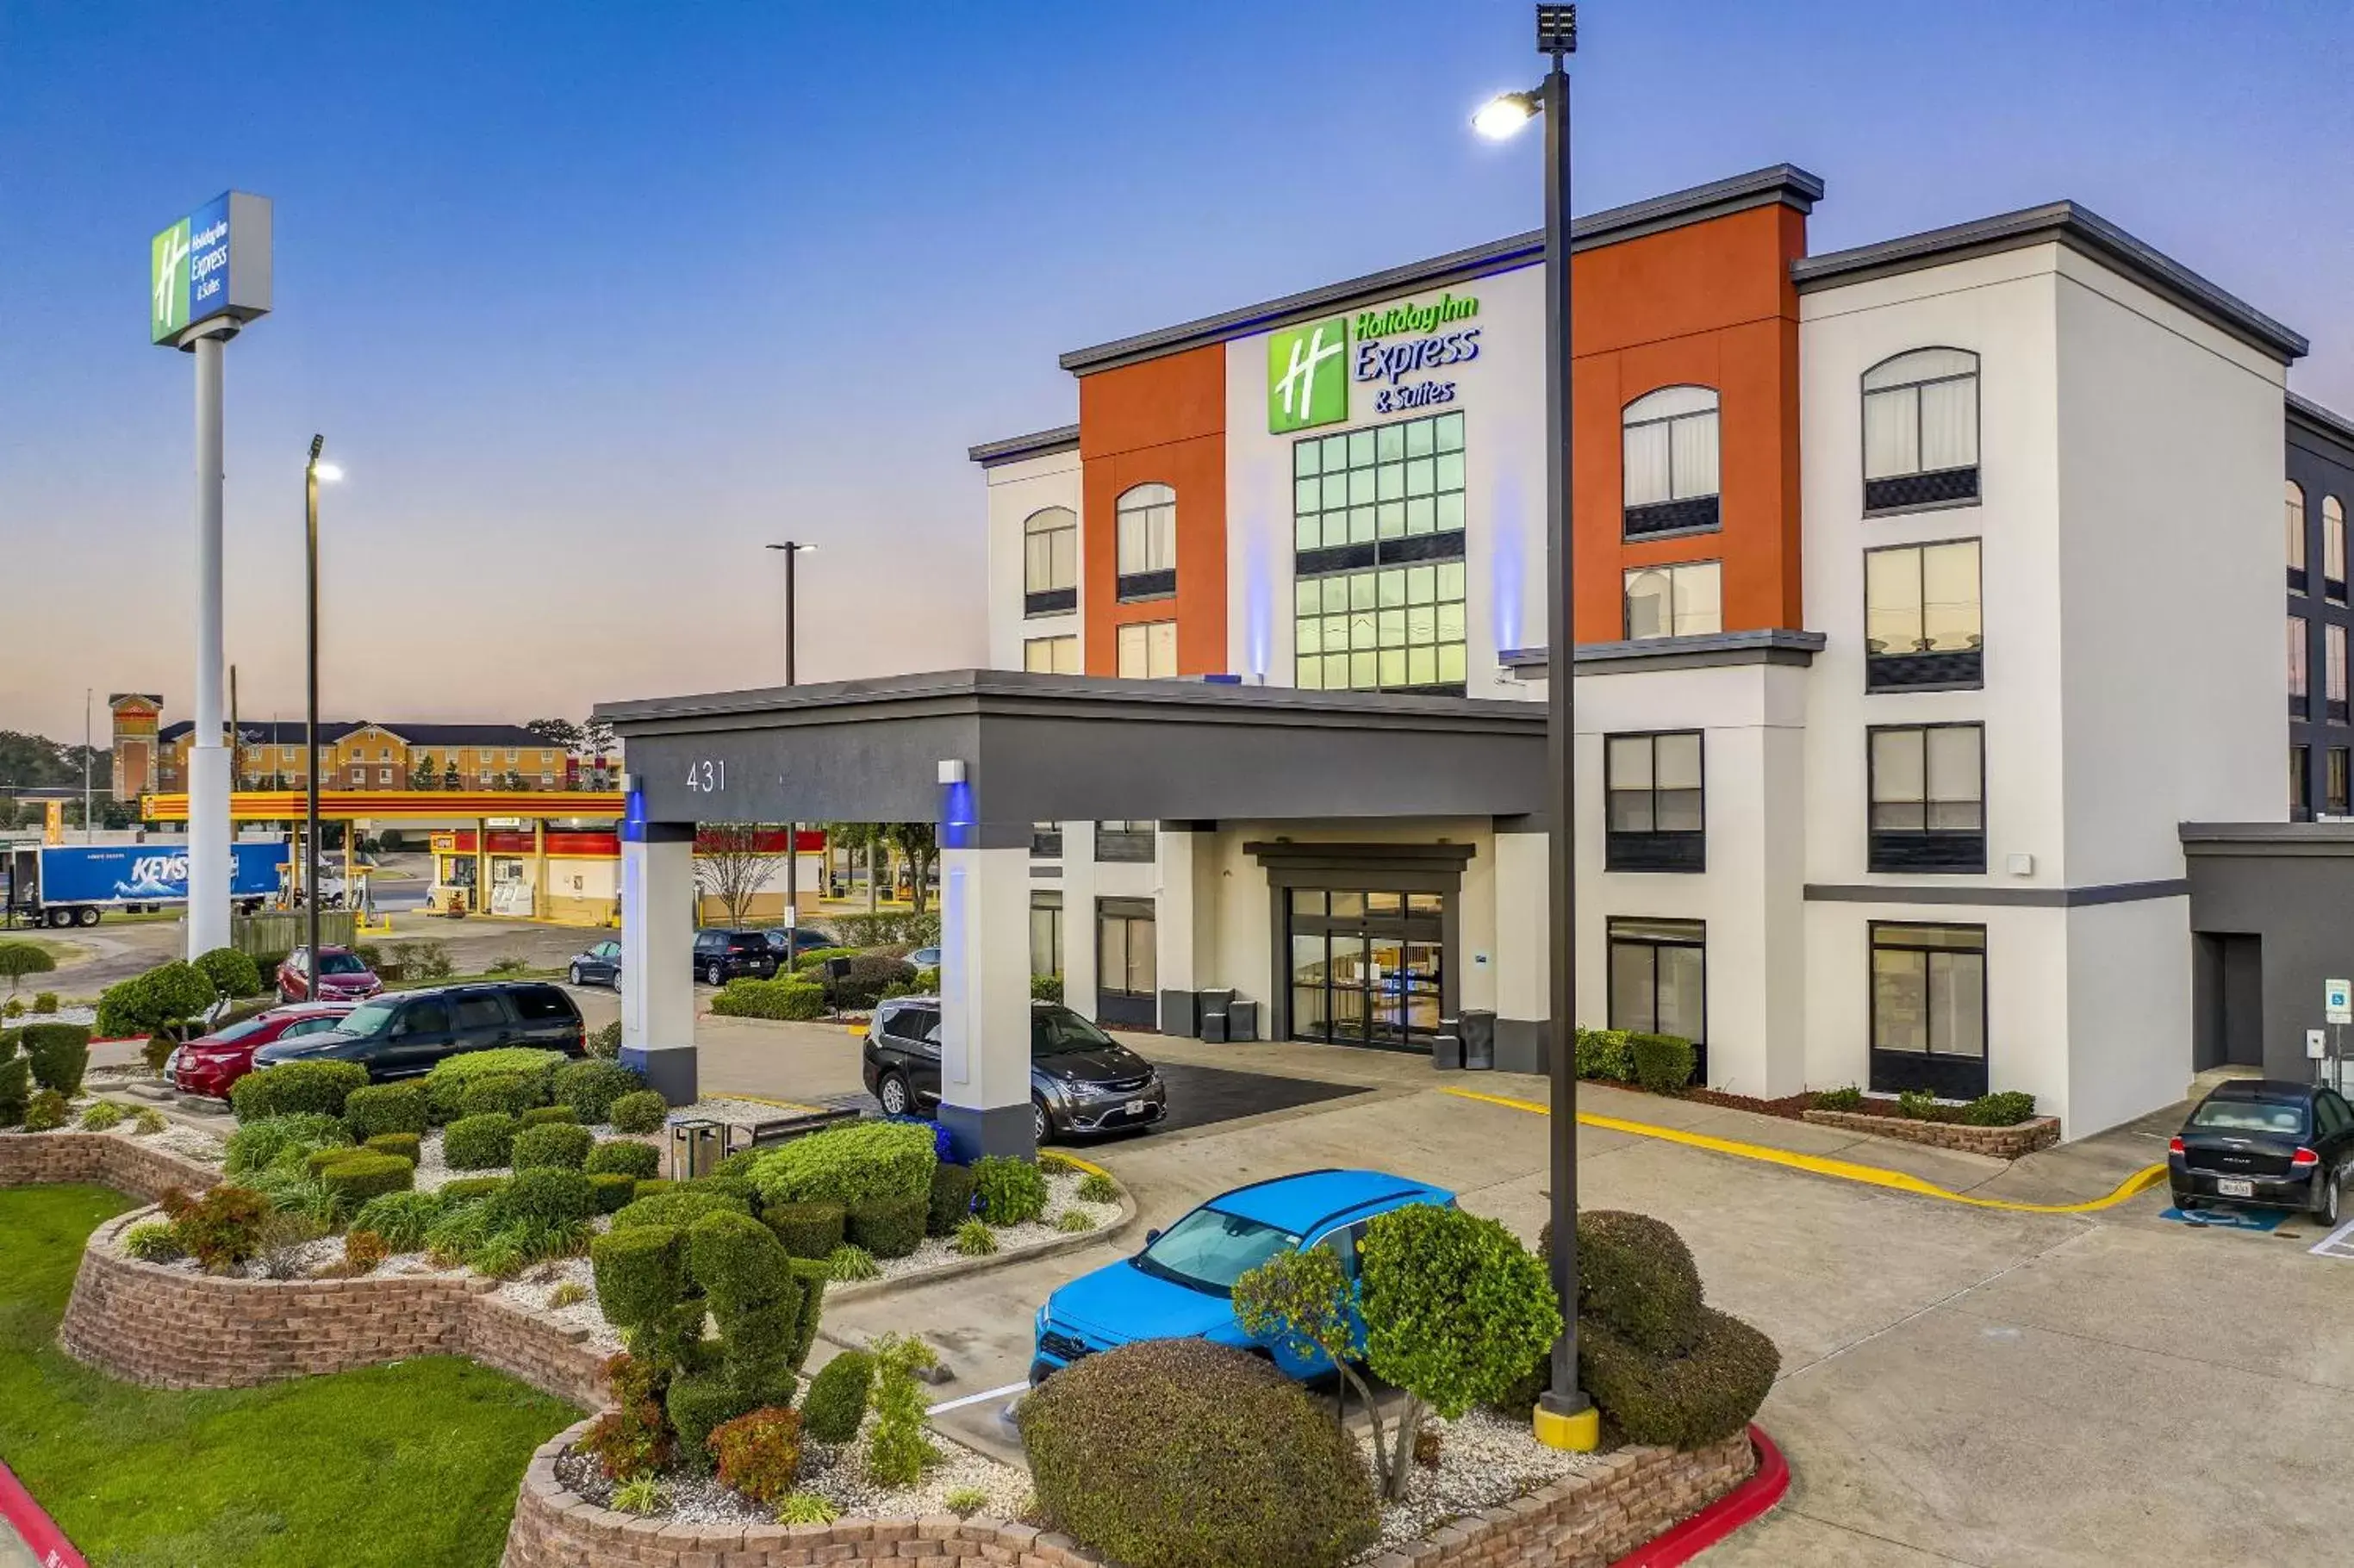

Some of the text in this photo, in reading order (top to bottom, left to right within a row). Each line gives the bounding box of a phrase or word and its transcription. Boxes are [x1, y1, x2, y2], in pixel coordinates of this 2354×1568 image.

[191, 243, 227, 282] Express
[1354, 293, 1479, 340] Holiday Inn
[1354, 329, 1481, 385] Express
[1374, 381, 1456, 414] & Suites
[687, 760, 726, 792] 431
